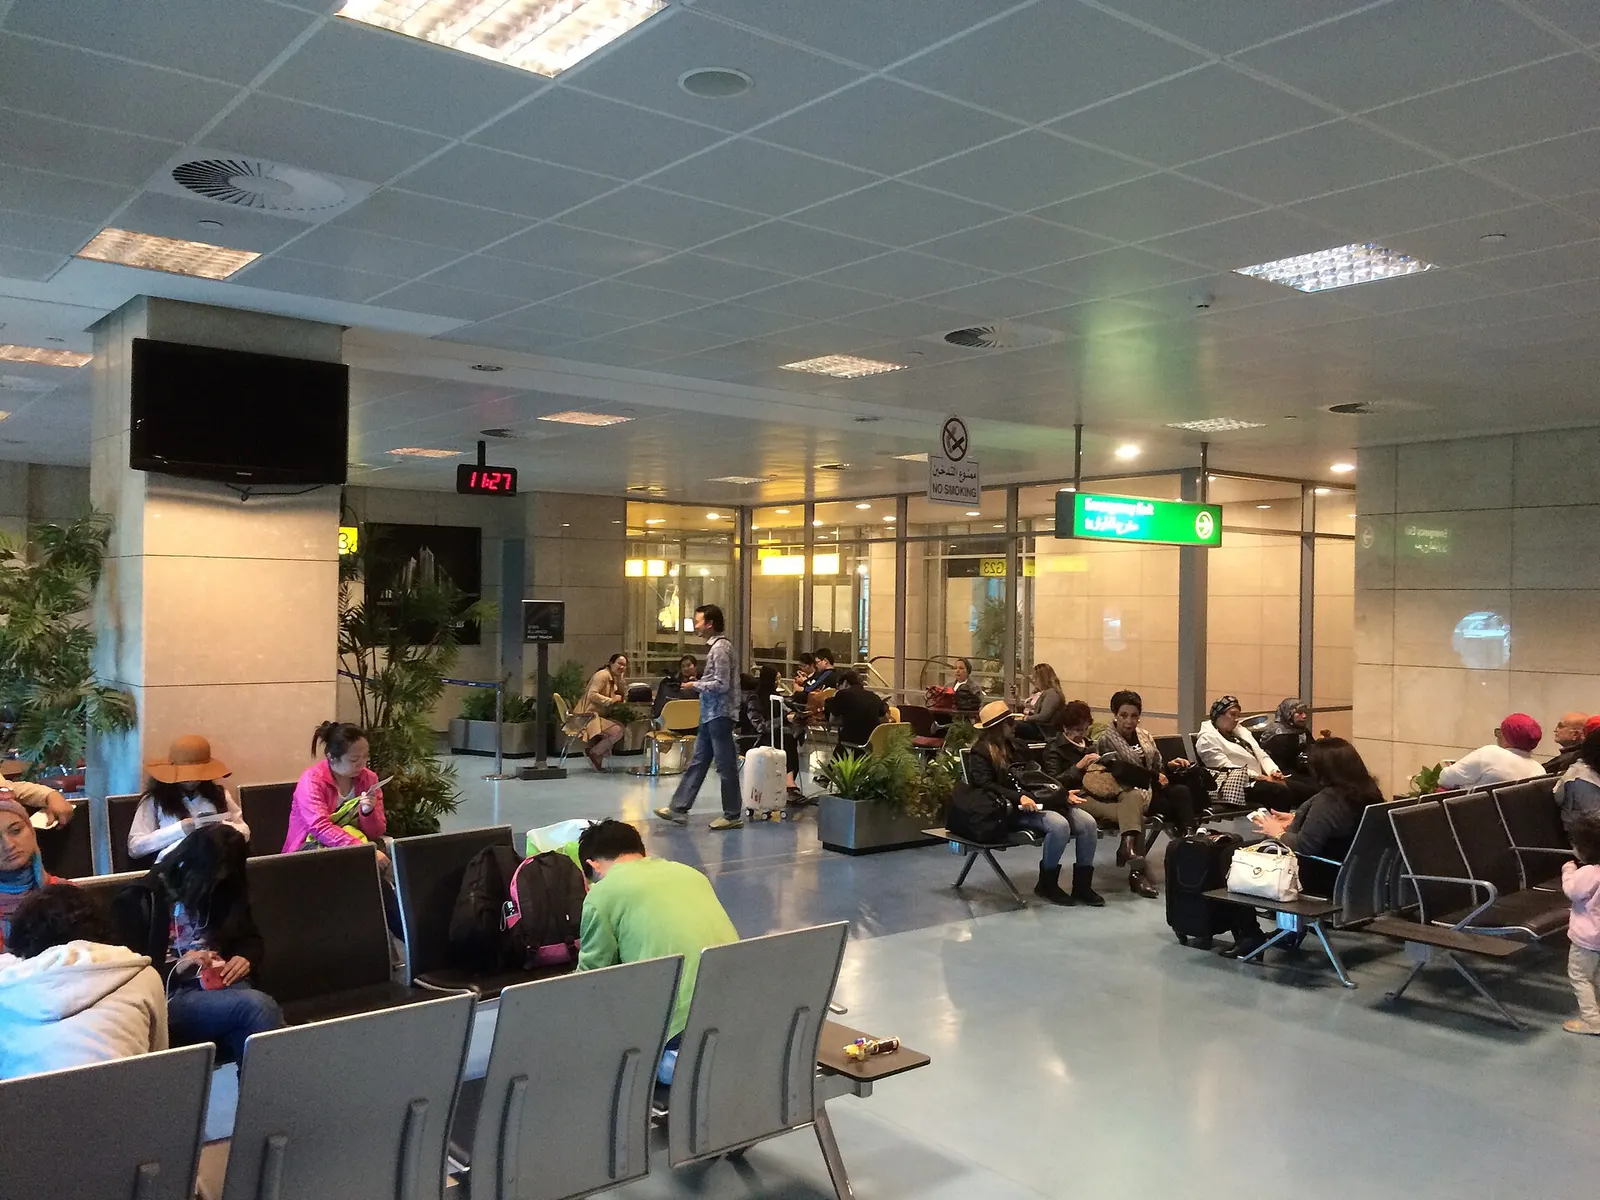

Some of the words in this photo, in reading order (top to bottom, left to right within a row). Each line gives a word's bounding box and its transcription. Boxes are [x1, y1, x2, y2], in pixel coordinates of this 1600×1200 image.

[932, 464, 958, 477] التدخين
[959, 469, 977, 483] ممنوع
[470, 471, 512, 490] 11:27
[932, 482, 943, 494] NO
[944, 484, 977, 498] SMOKING
